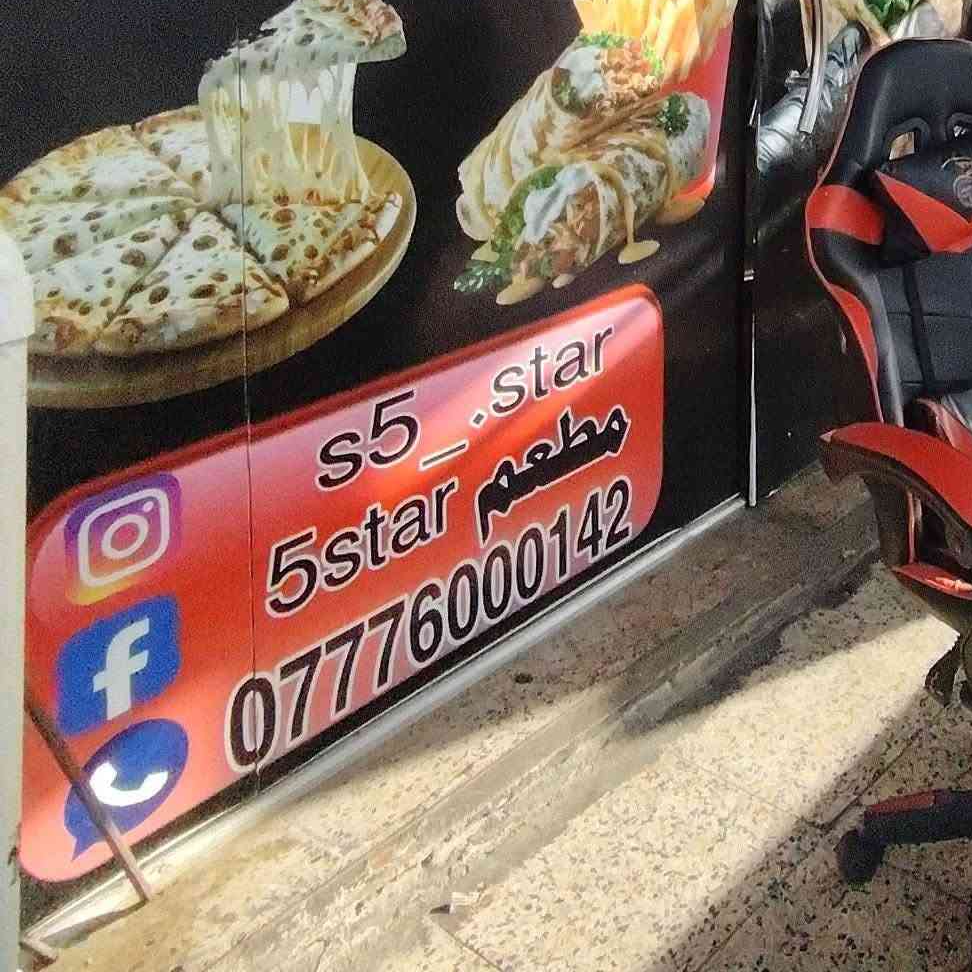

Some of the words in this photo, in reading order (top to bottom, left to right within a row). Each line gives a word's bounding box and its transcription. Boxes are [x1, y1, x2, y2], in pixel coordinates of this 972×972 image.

[226, 476, 633, 773] 07776000142
[266, 477, 459, 619] 5star
[476, 403, 632, 545] مطعم
